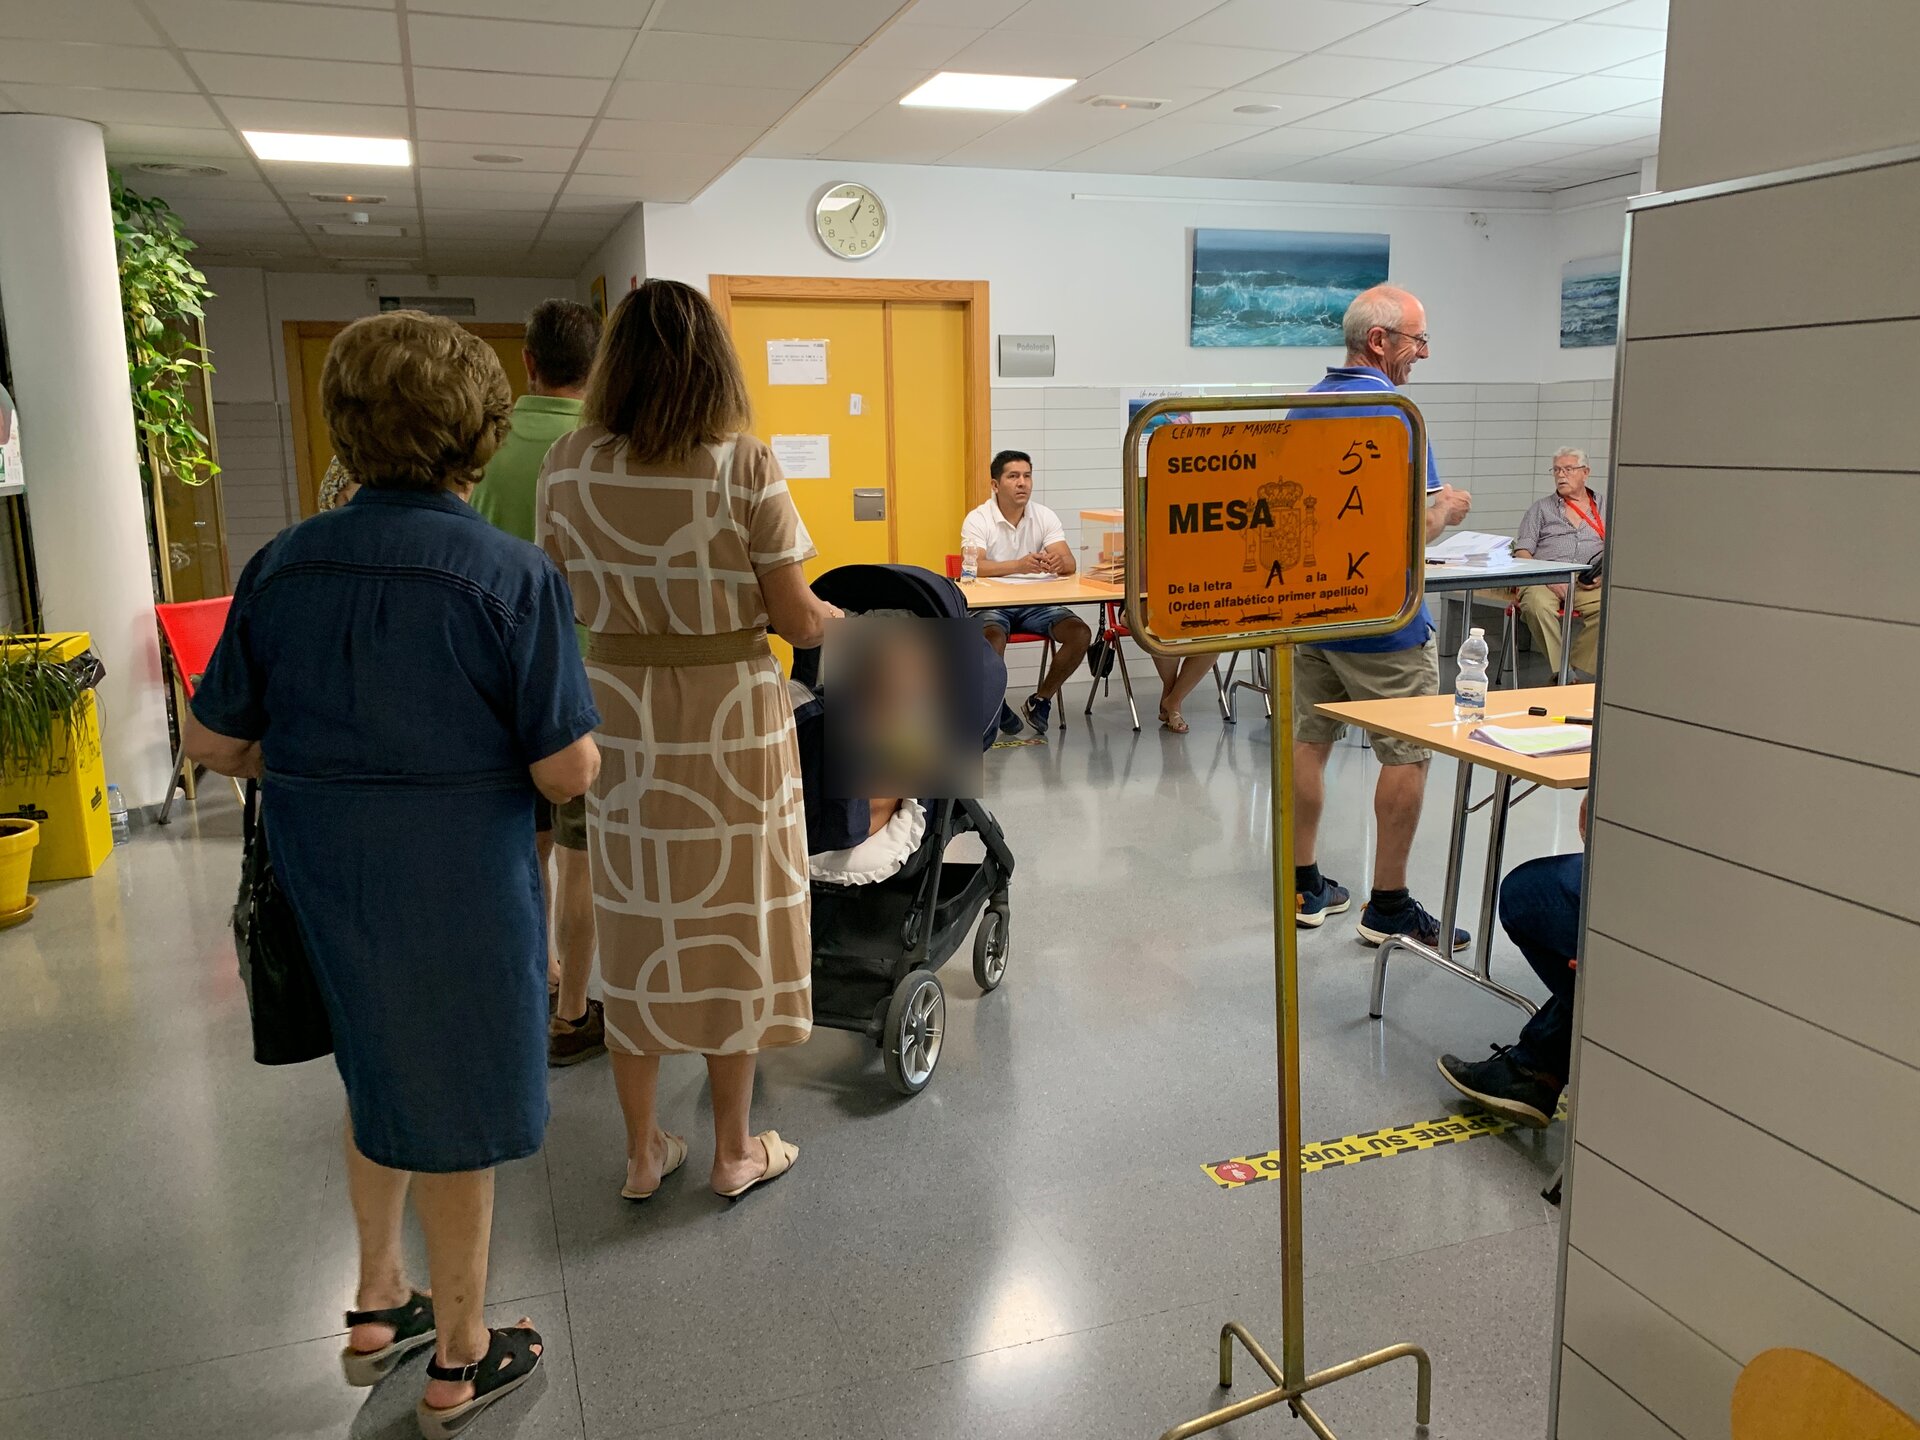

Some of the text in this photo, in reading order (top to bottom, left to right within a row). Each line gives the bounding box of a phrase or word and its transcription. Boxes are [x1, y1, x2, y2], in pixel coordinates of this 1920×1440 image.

[868, 204, 876, 214] 2
[824, 216, 832, 225] 9
[872, 217, 879, 227] 3
[828, 229, 835, 238] 8
[869, 230, 875, 238] 4
[839, 239, 845, 248] 7
[849, 243, 856, 252] 6
[861, 240, 868, 249] 5
[1172, 423, 1292, 440] CENTRO DE MAYORES
[1168, 449, 1257, 474] SECCIÓN
[1337, 485, 1364, 520] A
[1168, 498, 1275, 535] MESA
[1168, 552, 1370, 595] De la letra A a la K
[1168, 584, 1369, 614] (Orden alfabético primer apellido)
[1260, 1116, 1501, 1171] SPERE SU TURO
